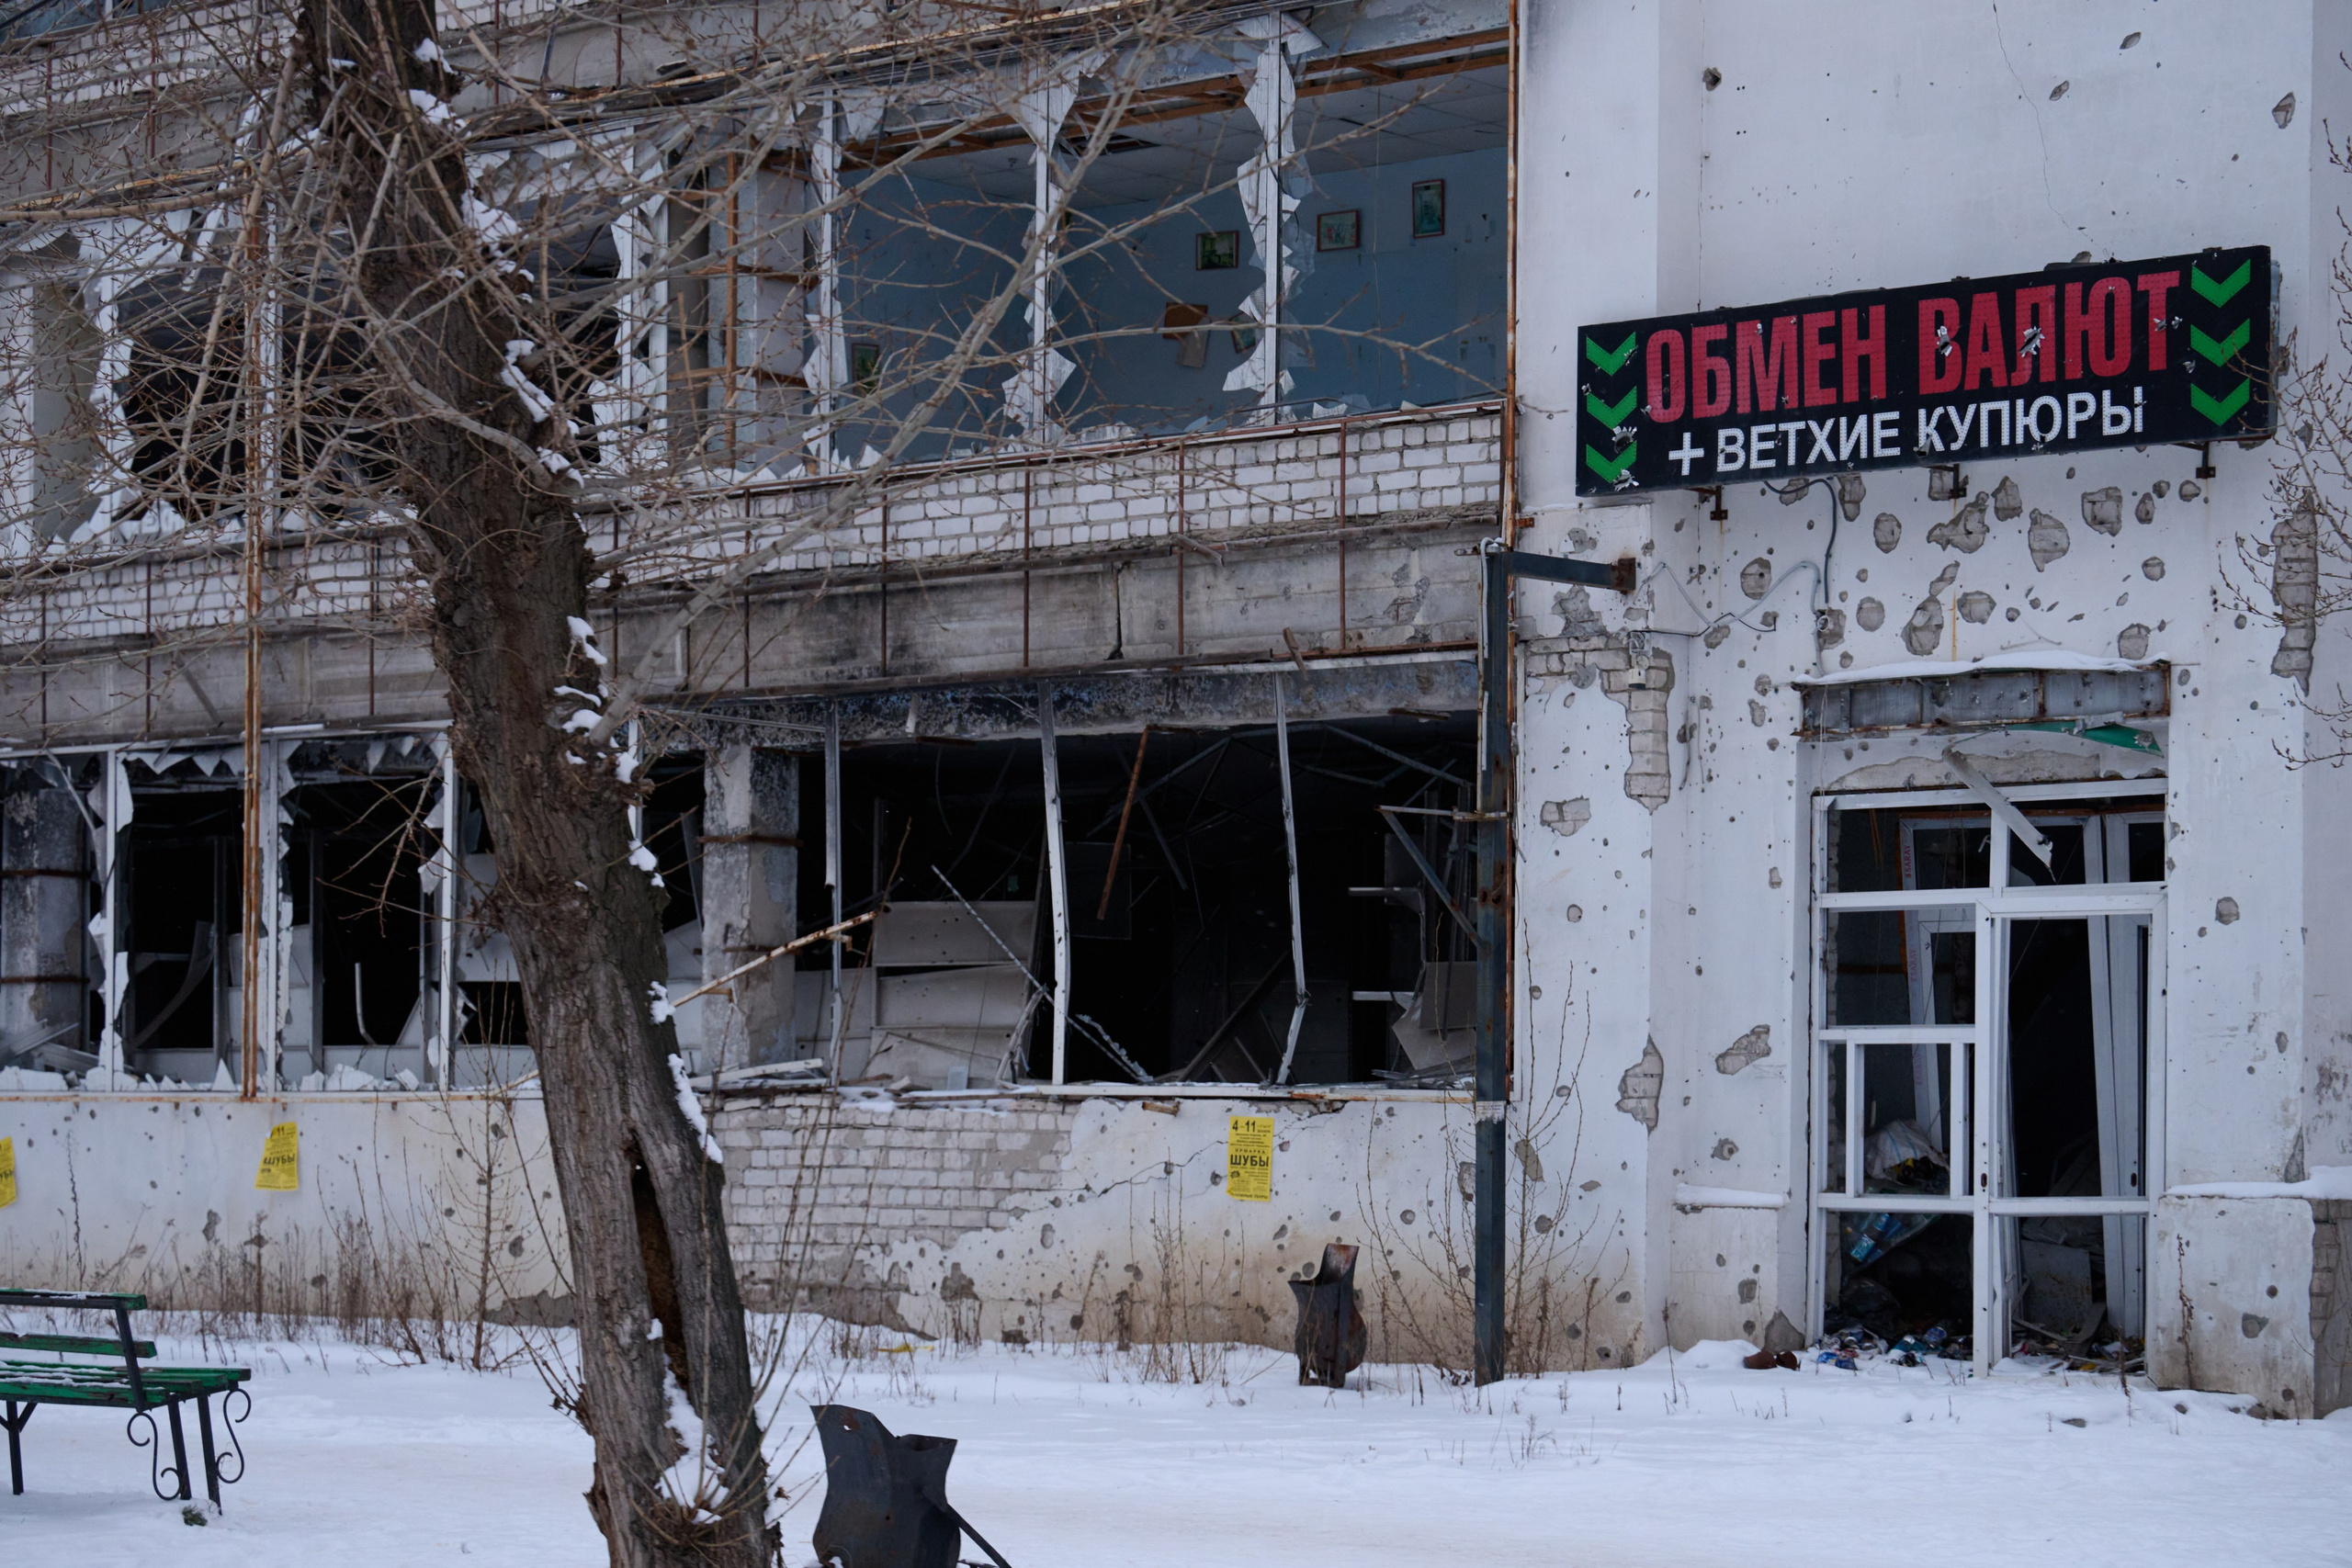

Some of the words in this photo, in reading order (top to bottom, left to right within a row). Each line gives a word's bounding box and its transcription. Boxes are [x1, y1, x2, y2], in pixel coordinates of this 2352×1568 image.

[1645, 305, 1886, 423] ОБМЕН
[1918, 270, 2180, 395] ВАЛЮТ
[1716, 411, 1900, 472] ВЕТХИЕ
[1917, 386, 2143, 451] КУПЮРЫ
[264, 1154, 295, 1165] ШУБЫ
[1230, 1154, 1269, 1167] ШУБЫ
